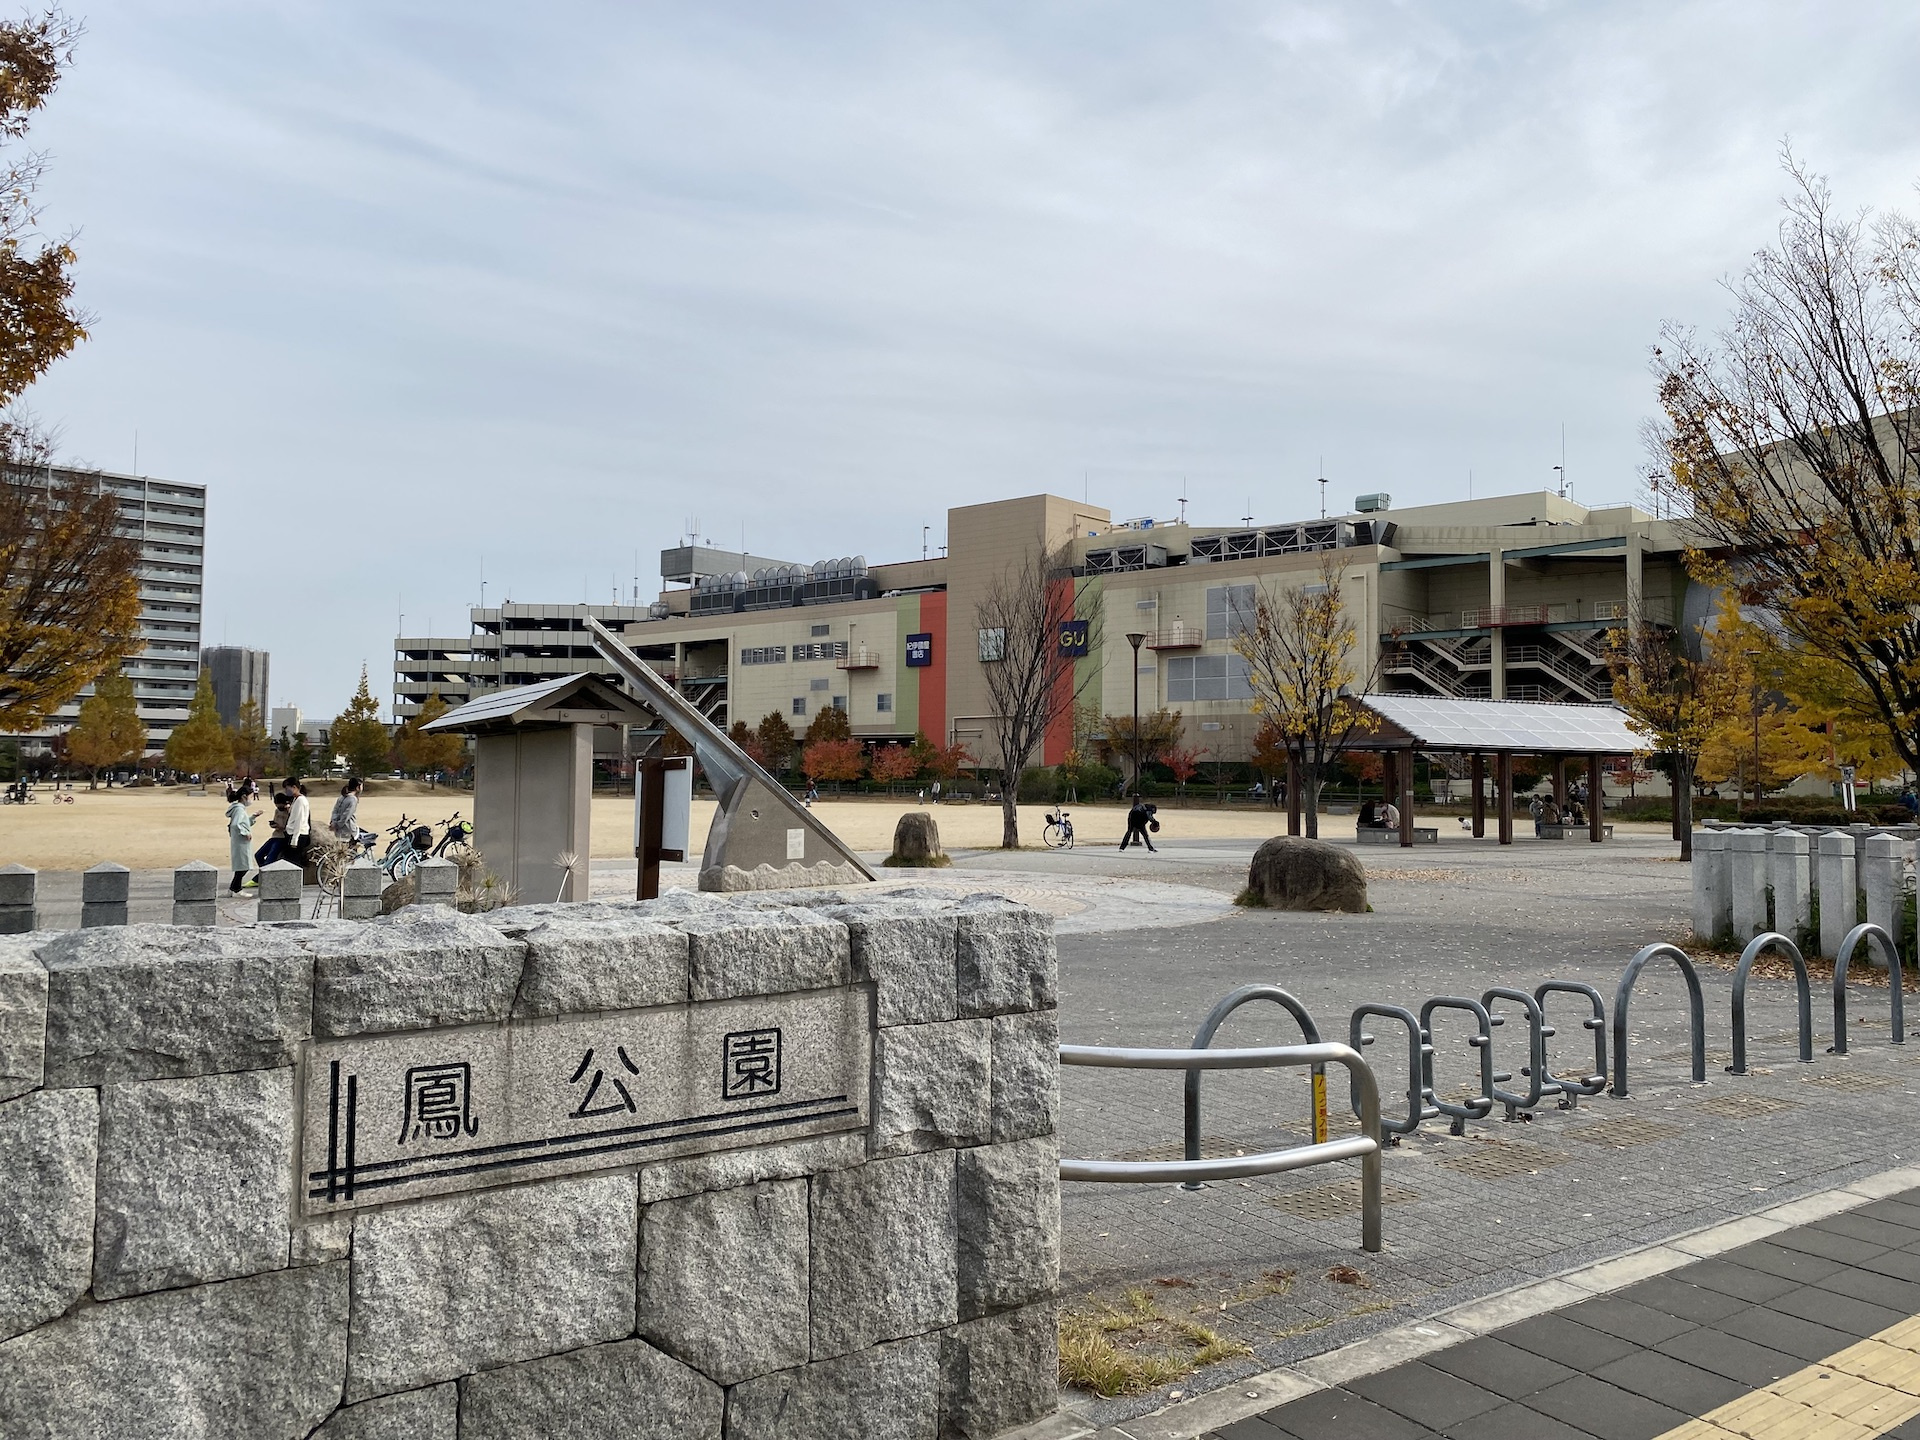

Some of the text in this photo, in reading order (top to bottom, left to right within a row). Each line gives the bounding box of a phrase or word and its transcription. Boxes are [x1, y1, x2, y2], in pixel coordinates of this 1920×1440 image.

[1060, 631, 1085, 647] GU
[397, 1027, 782, 1145] 鳳公園
